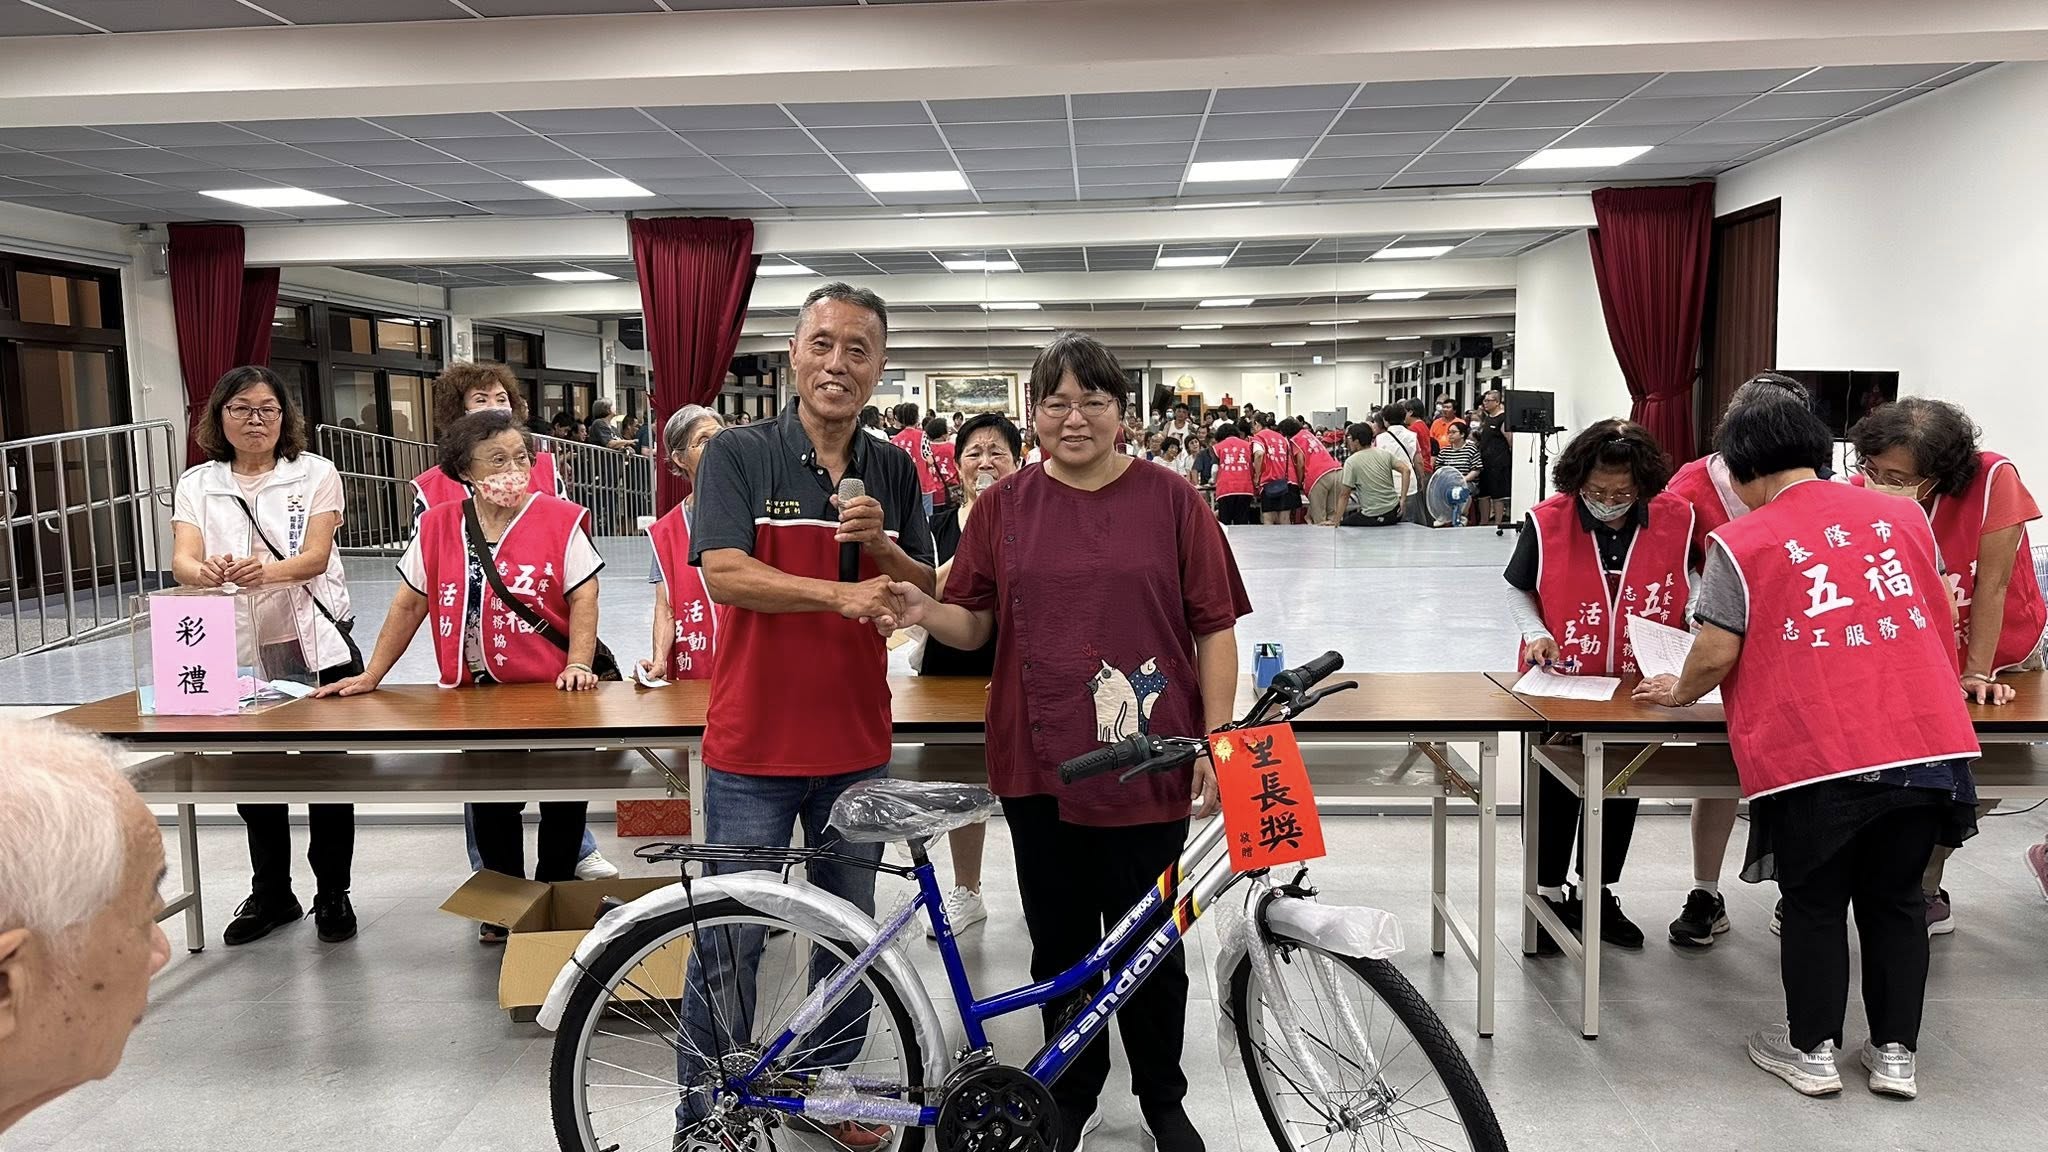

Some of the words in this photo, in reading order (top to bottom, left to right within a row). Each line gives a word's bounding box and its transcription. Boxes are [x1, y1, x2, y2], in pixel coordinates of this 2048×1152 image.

[1784, 519, 1893, 566] 基隆市
[491, 561, 508, 667] 志服務協會
[1660, 573, 1675, 624] 基隆市
[1801, 548, 1914, 619] 五福
[176, 615, 209, 695] 彩禮
[683, 600, 707, 652] 活動
[1579, 601, 1602, 655] 活動
[1246, 734, 1304, 853] 里長獎
